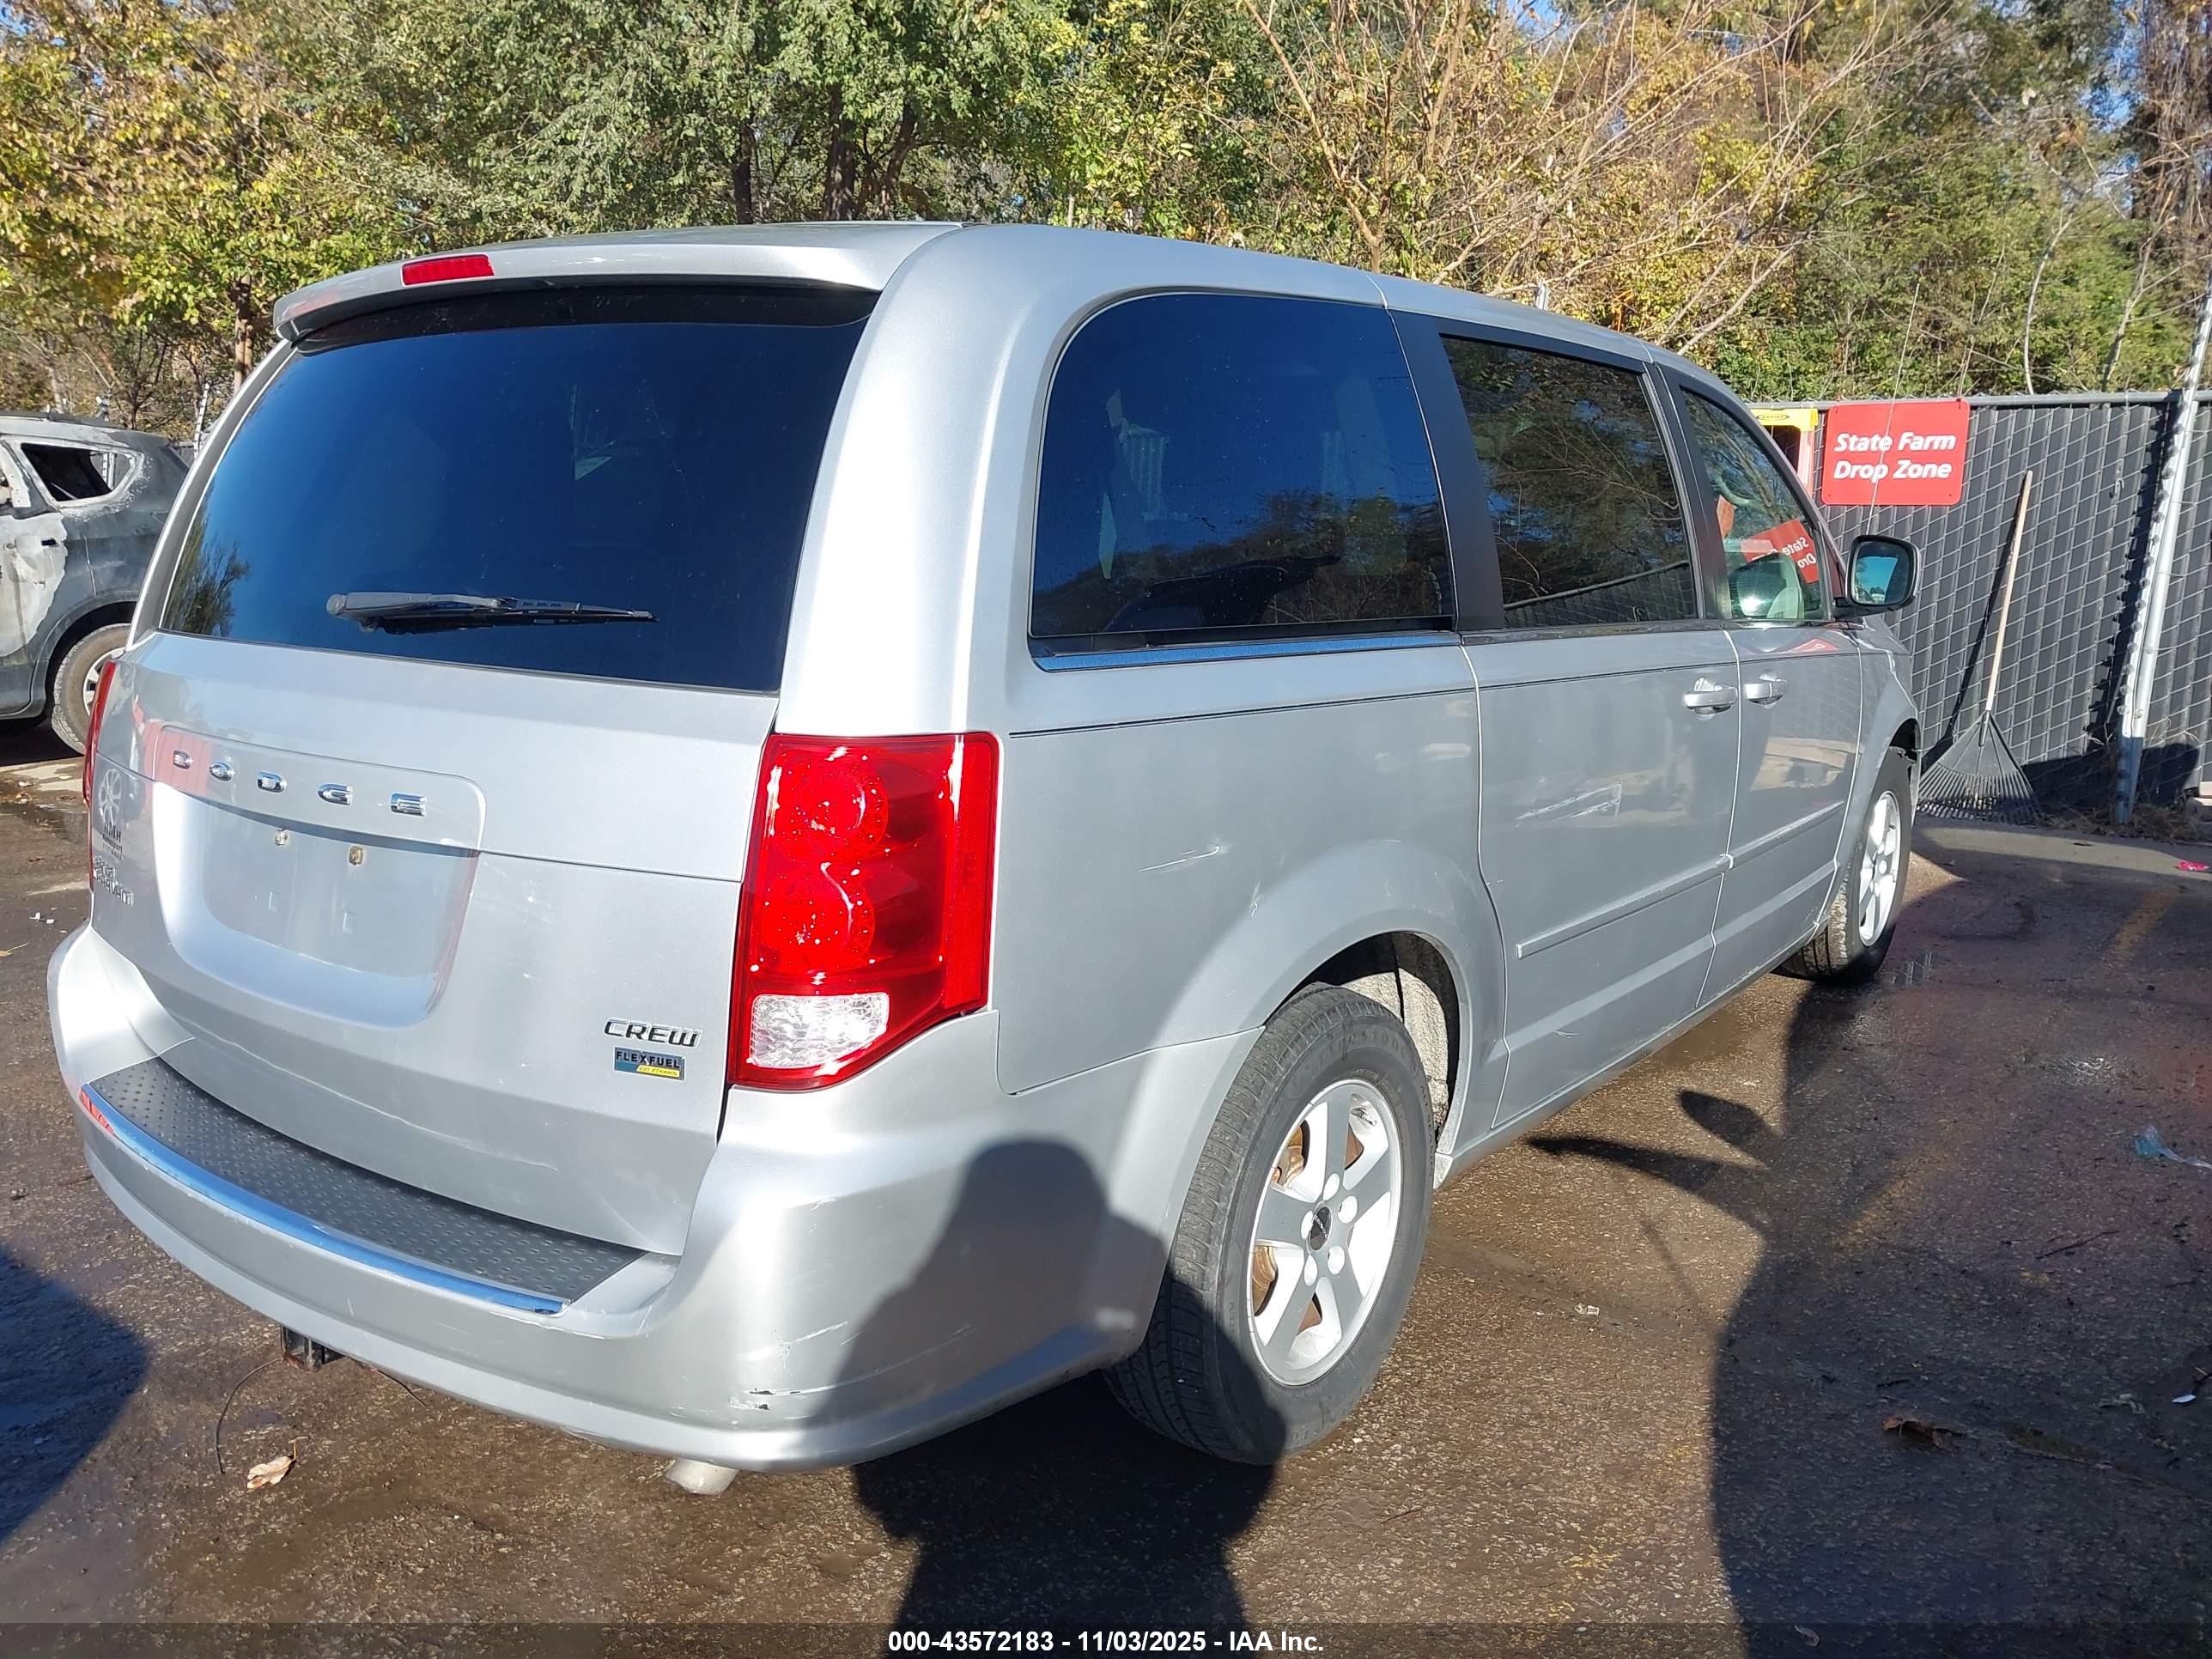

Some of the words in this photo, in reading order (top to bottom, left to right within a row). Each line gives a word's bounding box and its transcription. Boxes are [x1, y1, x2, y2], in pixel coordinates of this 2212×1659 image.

[1833, 433, 1893, 453] State
[1897, 432, 1956, 451] Farm
[1833, 460, 1890, 483] Drop
[1893, 459, 1953, 479] Zone
[173, 749, 427, 817] DODGE
[605, 1018, 702, 1048] CREW
[616, 1050, 681, 1068] FLEXFUEL
